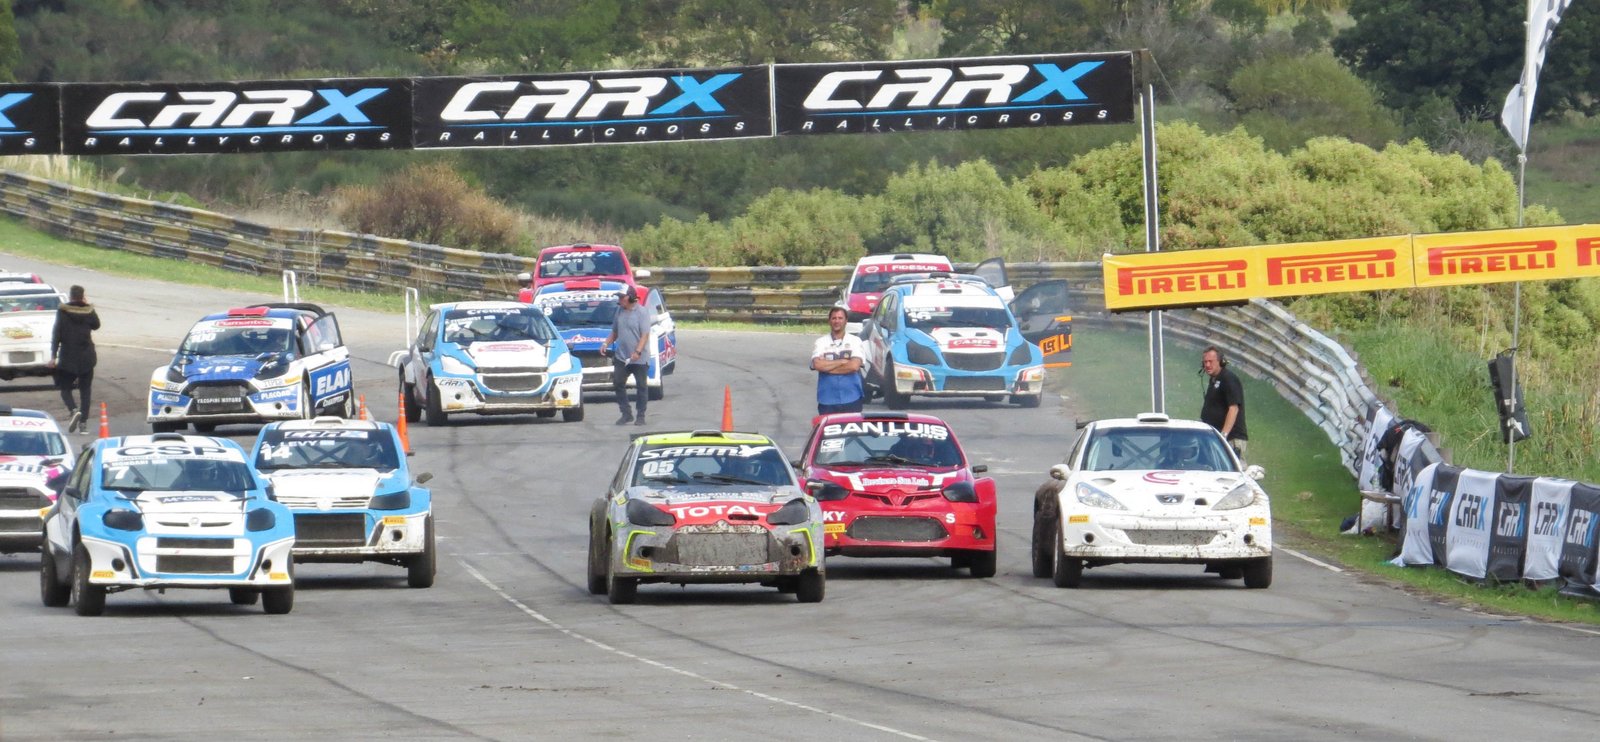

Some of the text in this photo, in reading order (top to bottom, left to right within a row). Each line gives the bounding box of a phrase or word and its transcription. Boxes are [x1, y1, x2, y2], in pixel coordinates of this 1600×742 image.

[803, 61, 1106, 110] CARX
[440, 73, 744, 121] CARX
[85, 87, 390, 128] CARX
[802, 109, 1108, 130] RALLYCROSS
[84, 132, 391, 147] RALLYCROSS
[439, 121, 745, 140] RALLYCROSS
[1267, 249, 1397, 286] PIRELLI
[1428, 240, 1558, 276] PIRELLI
[1118, 259, 1248, 296] PIRELLI
[544, 306, 553, 316] 8
[198, 365, 246, 374] YPF
[823, 422, 948, 438] SAN LUIS
[117, 445, 227, 456] CSP
[260, 443, 293, 461] 14
[108, 466, 130, 480] 7
[642, 460, 675, 475] 05
[669, 505, 767, 519] TOTAL
[1456, 493, 1488, 531] CARX
[1497, 501, 1526, 537] CARX
